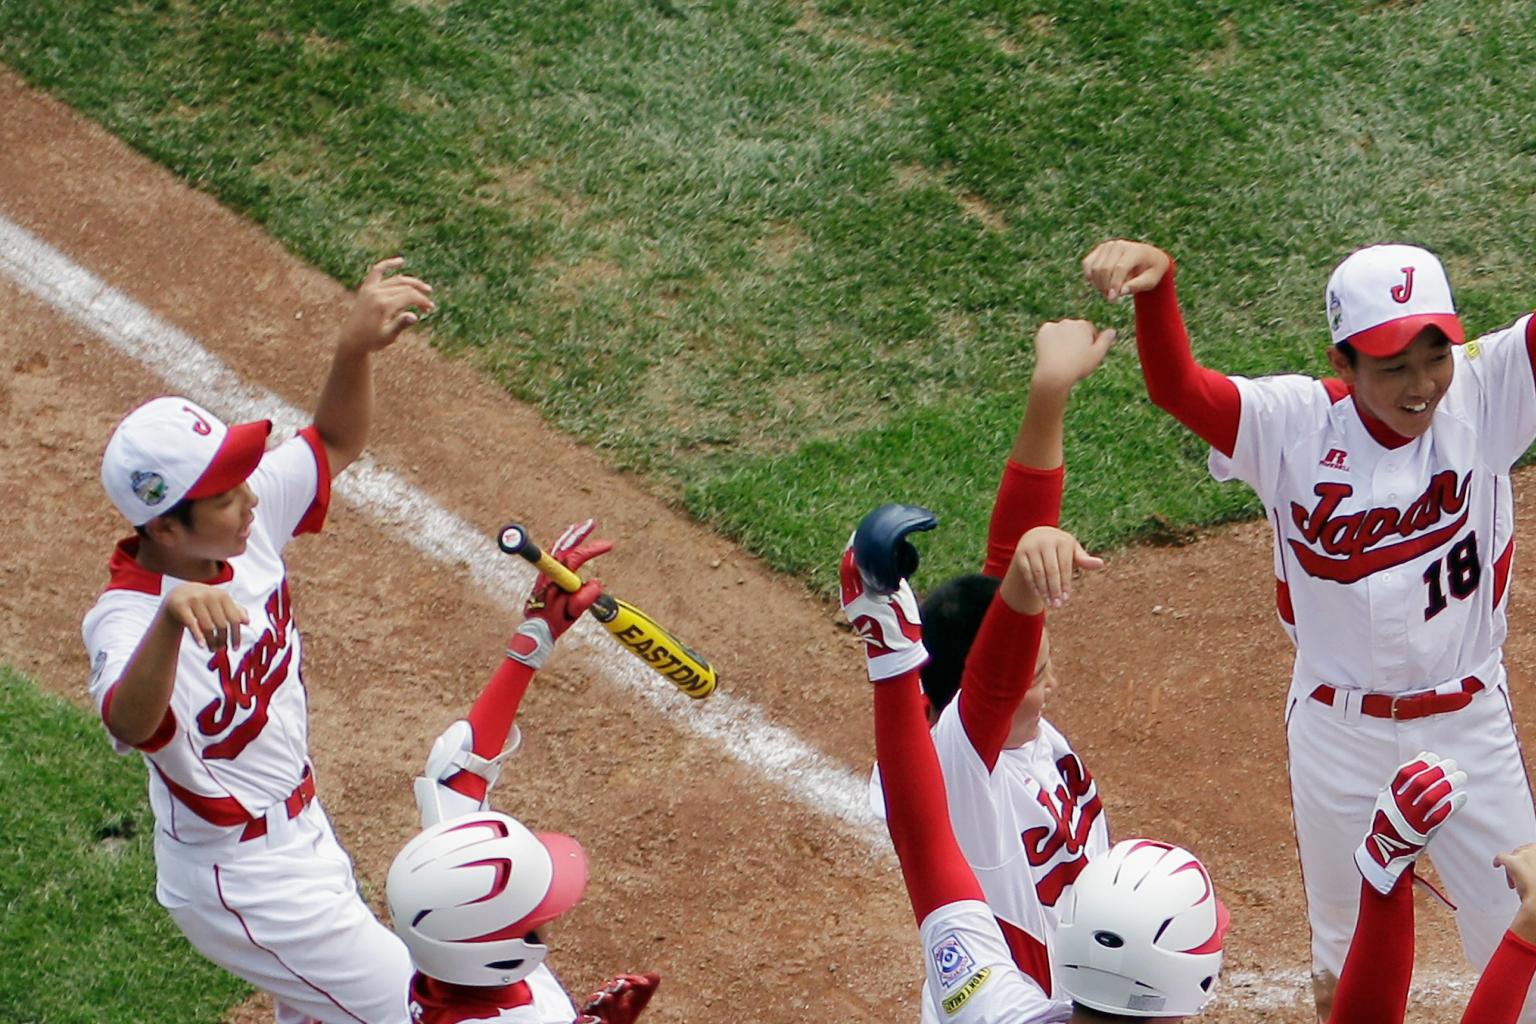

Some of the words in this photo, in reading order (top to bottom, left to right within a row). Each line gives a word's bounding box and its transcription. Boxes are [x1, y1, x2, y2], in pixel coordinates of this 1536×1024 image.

[1390, 266, 1415, 304] J
[182, 405, 211, 435] J
[1290, 470, 1473, 565] Japan
[1423, 530, 1481, 622] 18
[614, 624, 708, 693] EASTON
